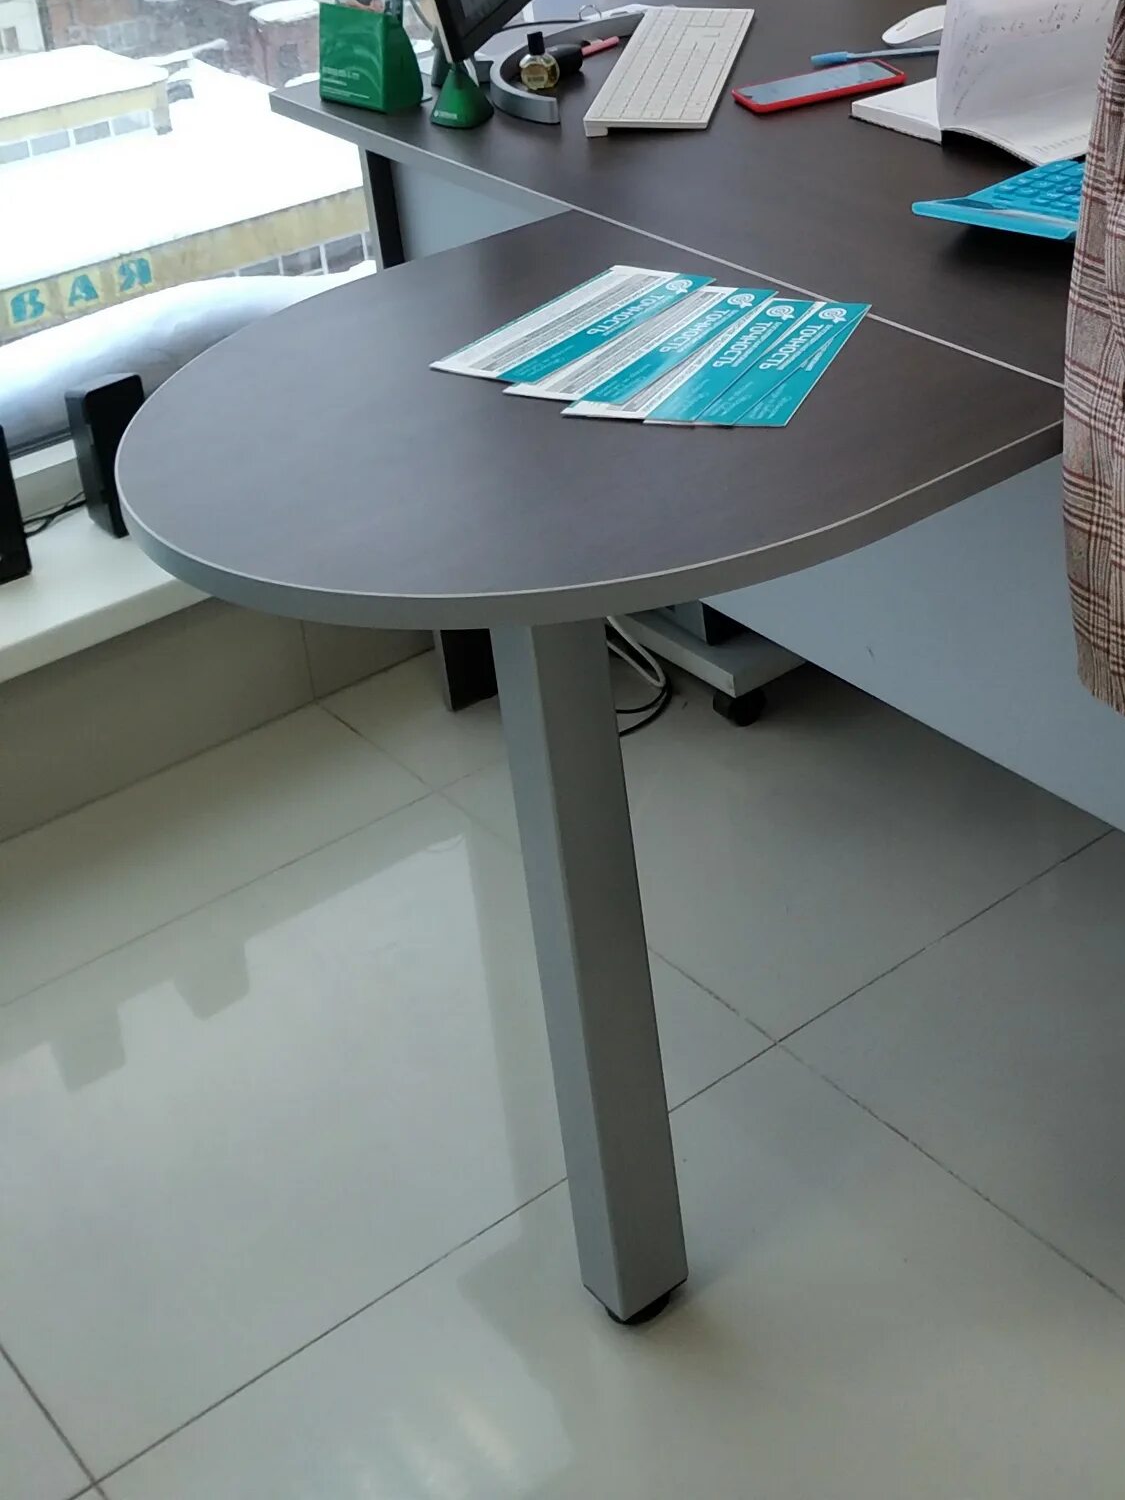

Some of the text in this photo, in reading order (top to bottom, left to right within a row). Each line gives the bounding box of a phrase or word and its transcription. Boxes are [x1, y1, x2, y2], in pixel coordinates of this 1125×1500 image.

[586, 293, 665, 335] ТОЧНОСТЬ
[659, 308, 730, 353] ТОЧНОСТЬ
[712, 321, 775, 368] ТОЧНОСТЬ
[759, 324, 823, 370] ТОЧНОСТЬ
